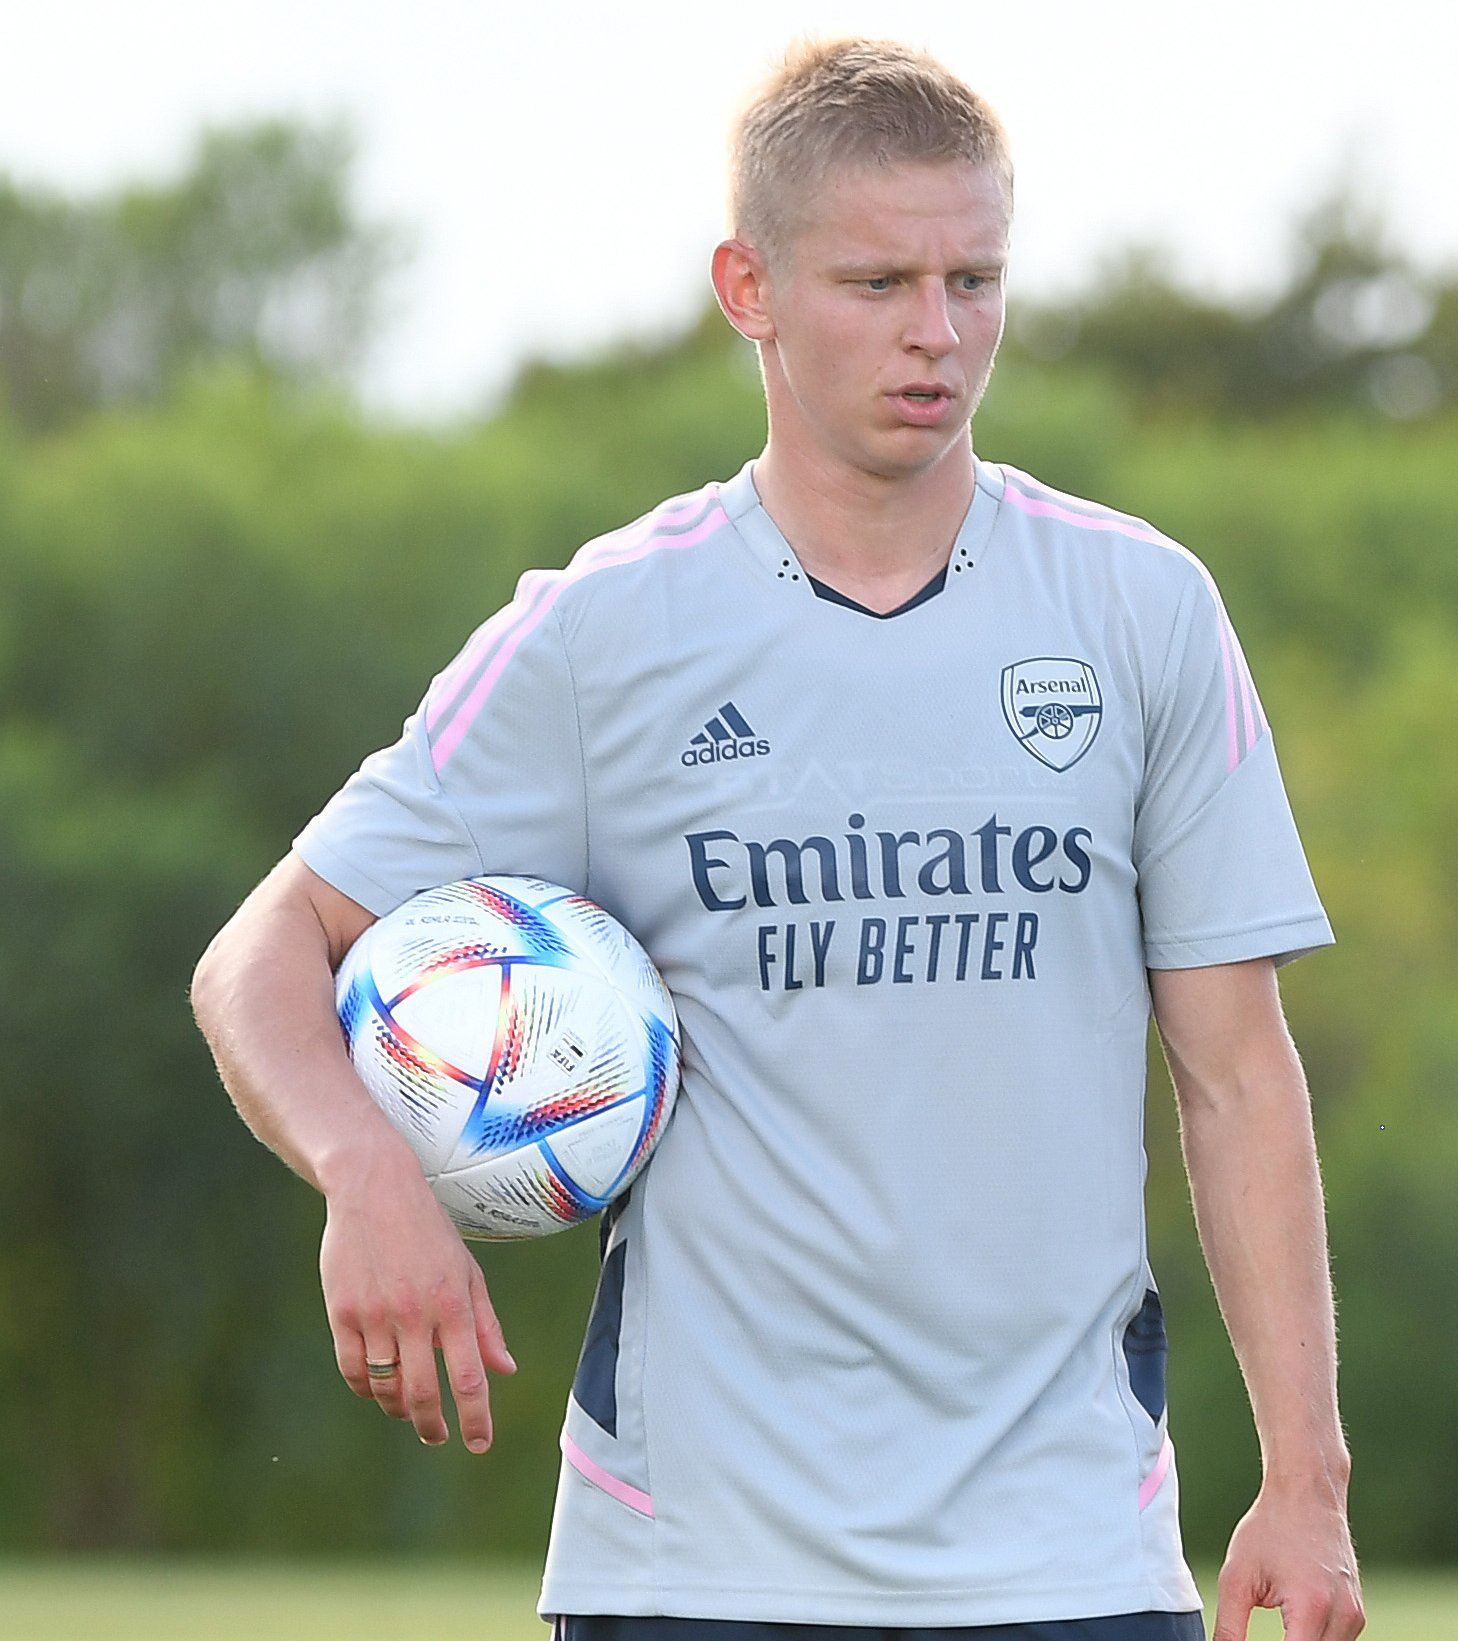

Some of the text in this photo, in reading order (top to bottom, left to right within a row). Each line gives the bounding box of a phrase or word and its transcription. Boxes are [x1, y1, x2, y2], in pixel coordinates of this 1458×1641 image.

[1016, 675, 1087, 695] Arsenal
[681, 735, 771, 767] adidas
[684, 812, 1093, 912] Emirates
[758, 912, 1040, 991] FLY BETTER
[549, 1047, 577, 1074] FIFA
